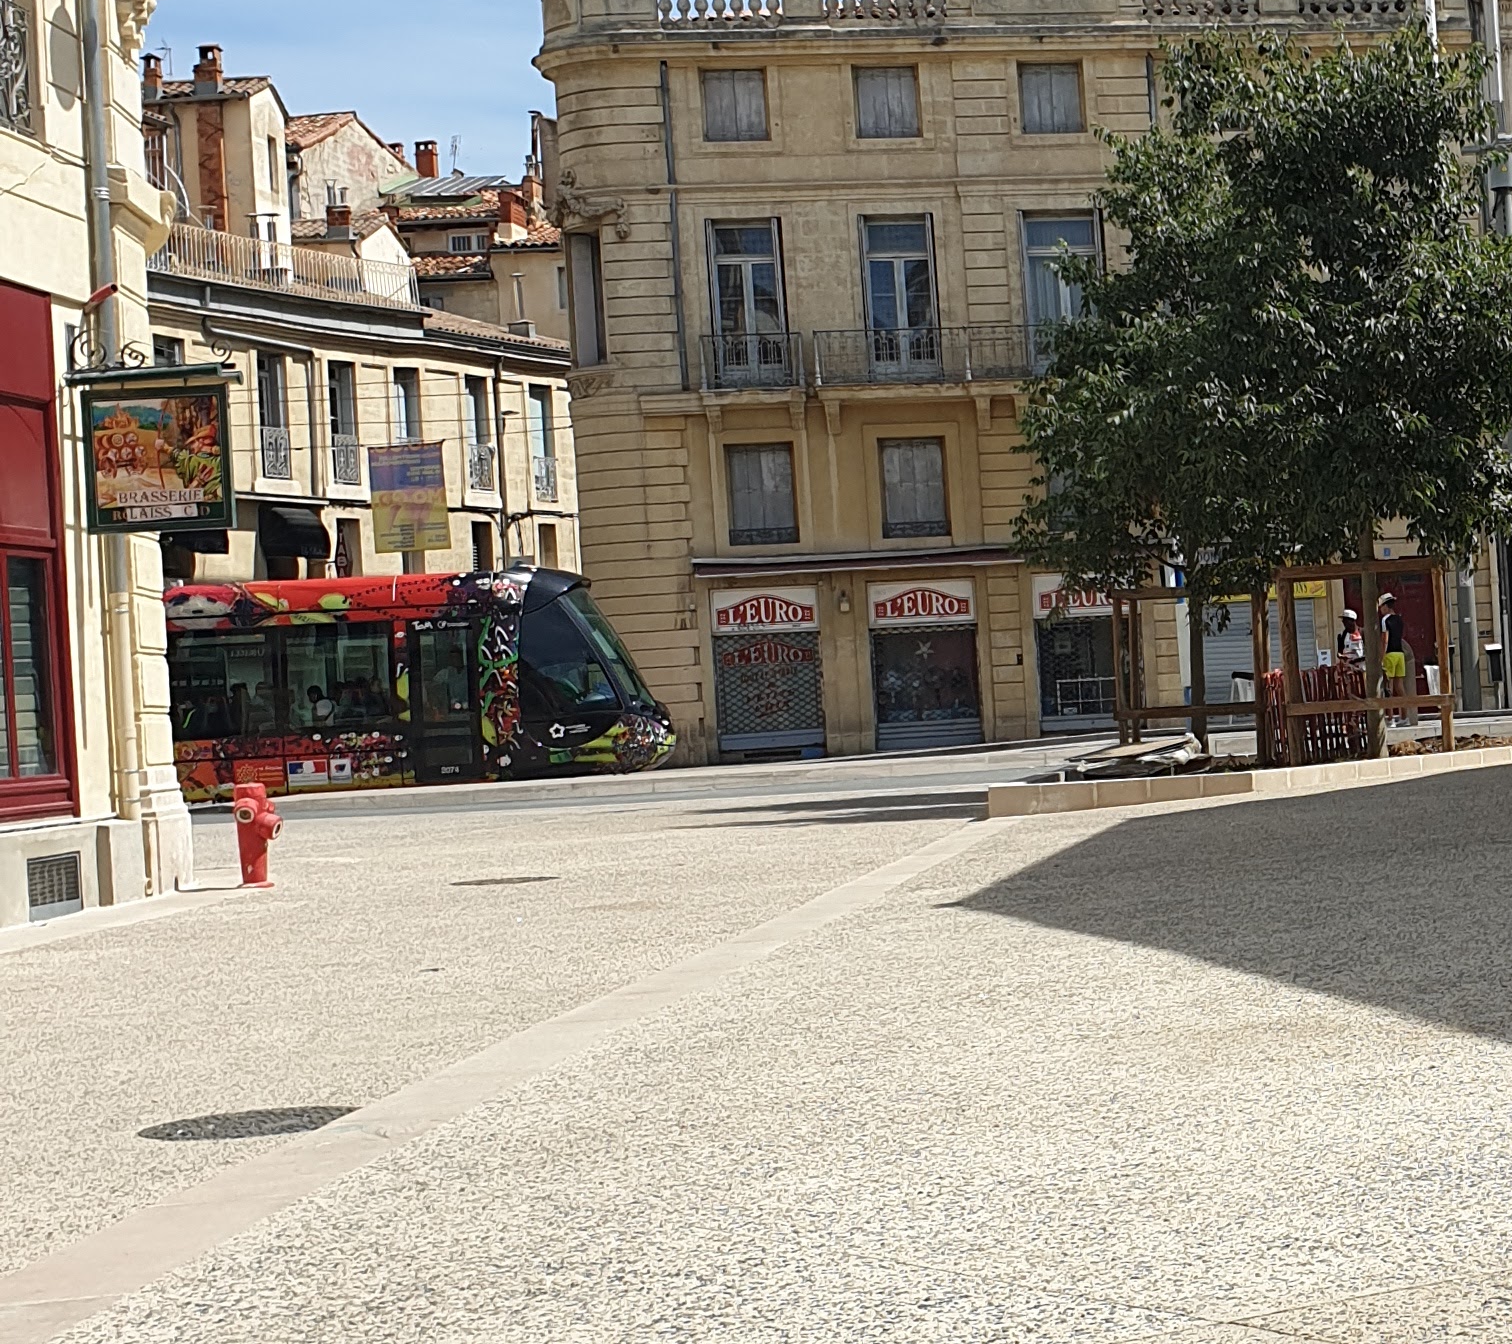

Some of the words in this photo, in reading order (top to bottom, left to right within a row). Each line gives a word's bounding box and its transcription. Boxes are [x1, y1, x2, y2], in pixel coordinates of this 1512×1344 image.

[118, 490, 202, 505] BRASSERIE
[728, 598, 803, 624] L'EURO
[885, 591, 959, 617] L'EURO
